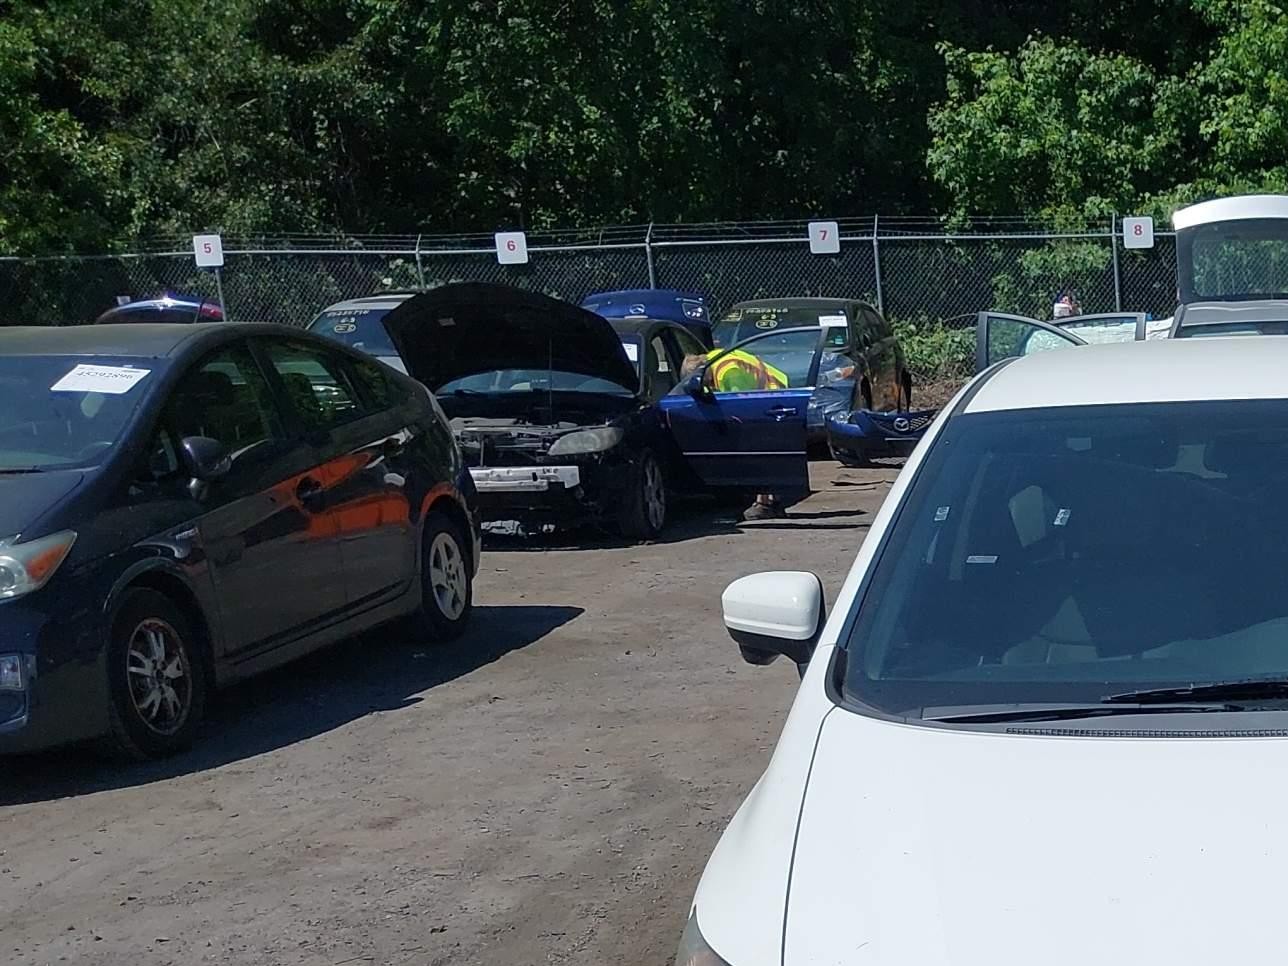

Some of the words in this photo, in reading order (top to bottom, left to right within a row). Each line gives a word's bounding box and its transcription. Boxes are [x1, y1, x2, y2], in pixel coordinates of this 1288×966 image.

[819, 230, 828, 241] 7
[1134, 224, 1143, 236] 8
[203, 242, 212, 254] 5
[506, 240, 516, 252] 6
